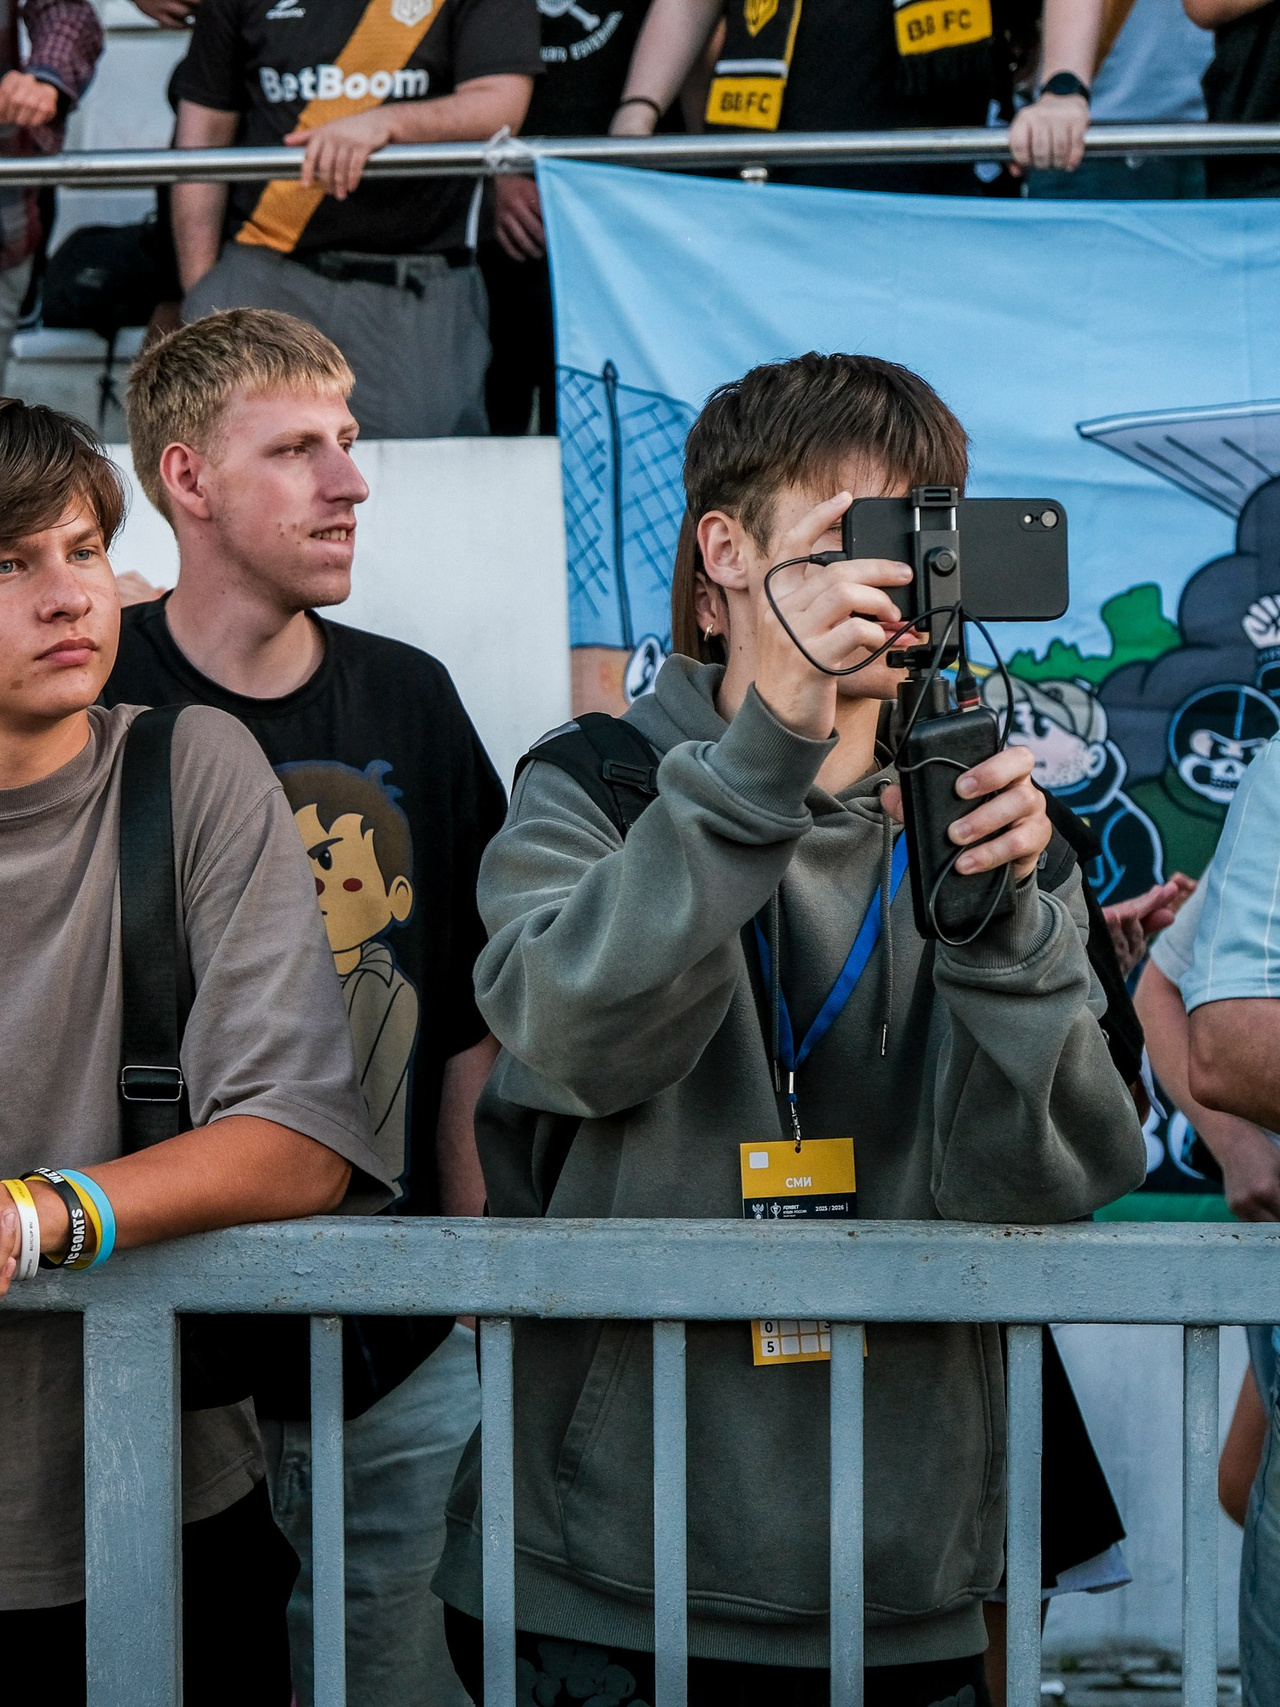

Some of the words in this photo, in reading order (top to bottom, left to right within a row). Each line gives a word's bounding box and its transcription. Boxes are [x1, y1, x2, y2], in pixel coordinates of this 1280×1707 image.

[943, 8, 972, 31] FC
[258, 64, 430, 103] BetBoom
[786, 1177, 812, 1188] СМИ
[71, 1208, 85, 1252] GOATS
[764, 1321, 773, 1333] 0
[767, 1341, 775, 1353] 5
